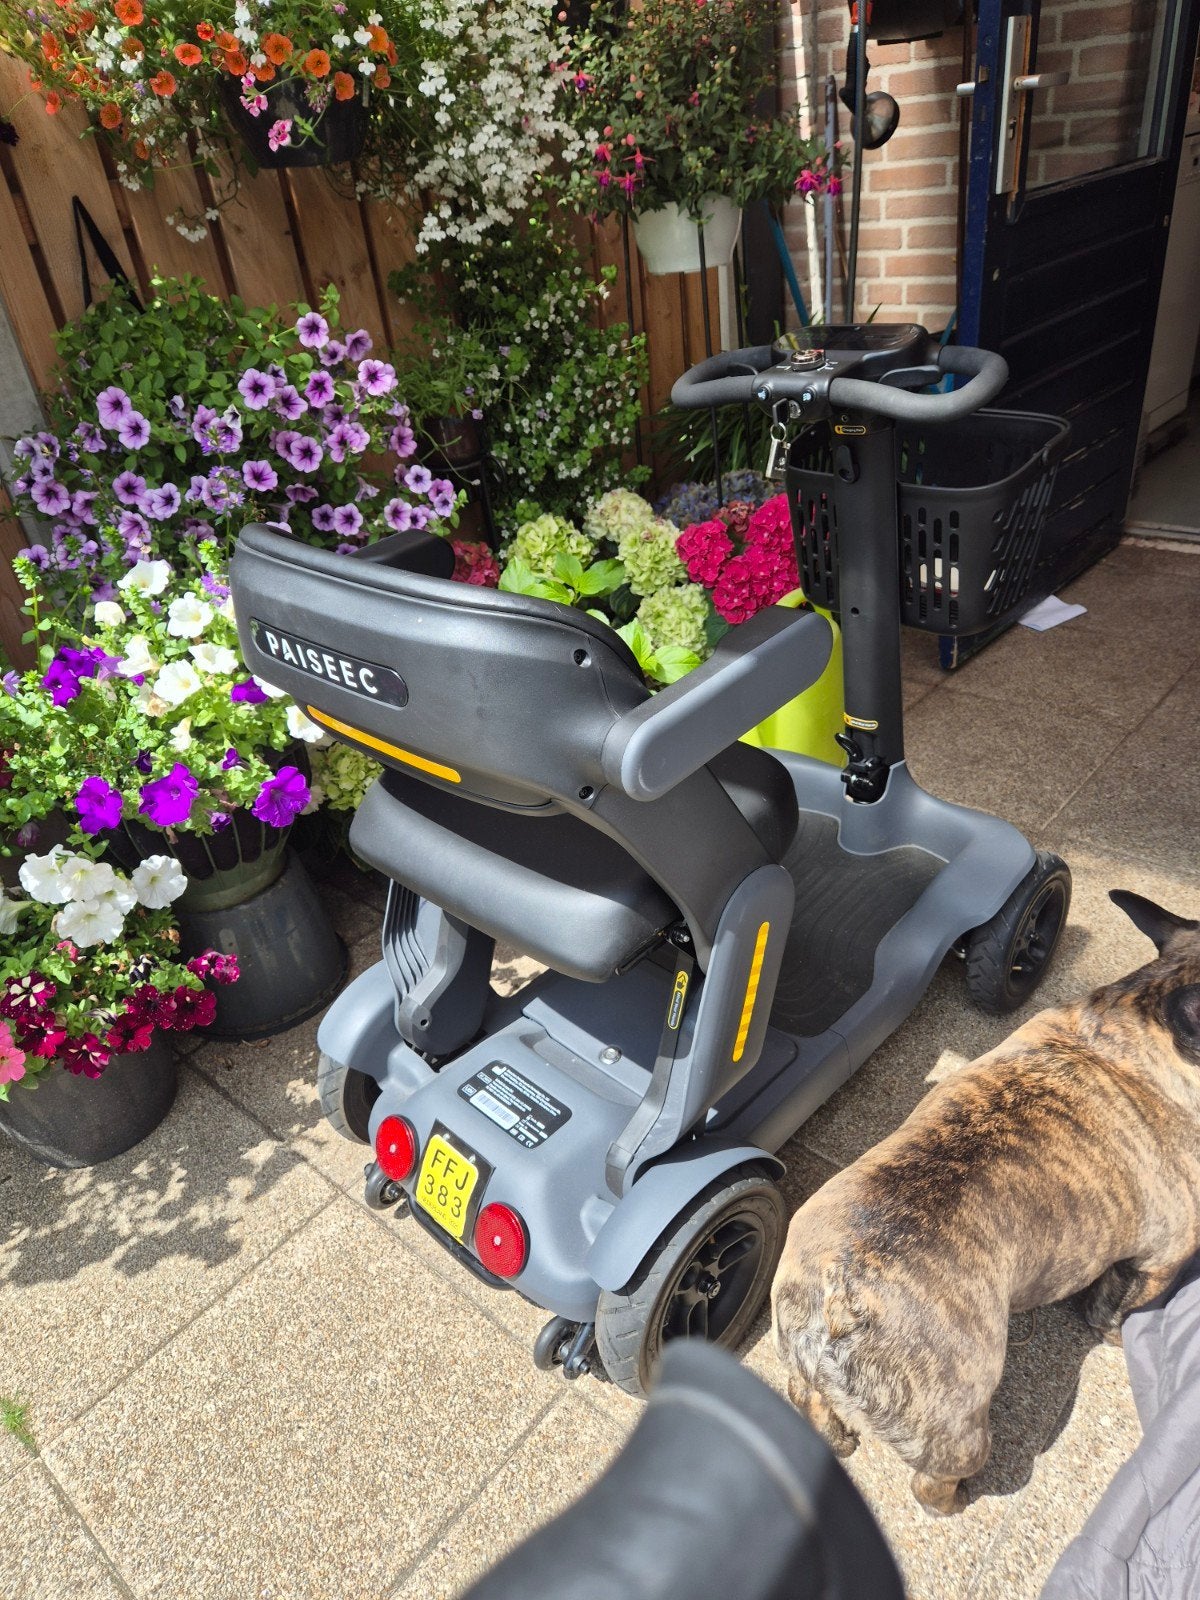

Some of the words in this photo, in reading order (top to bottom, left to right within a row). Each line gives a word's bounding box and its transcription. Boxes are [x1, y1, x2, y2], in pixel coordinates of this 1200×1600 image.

[265, 630, 378, 694] PAISEEC
[431, 1149, 469, 1190] FFJ
[425, 1174, 462, 1218] 383
